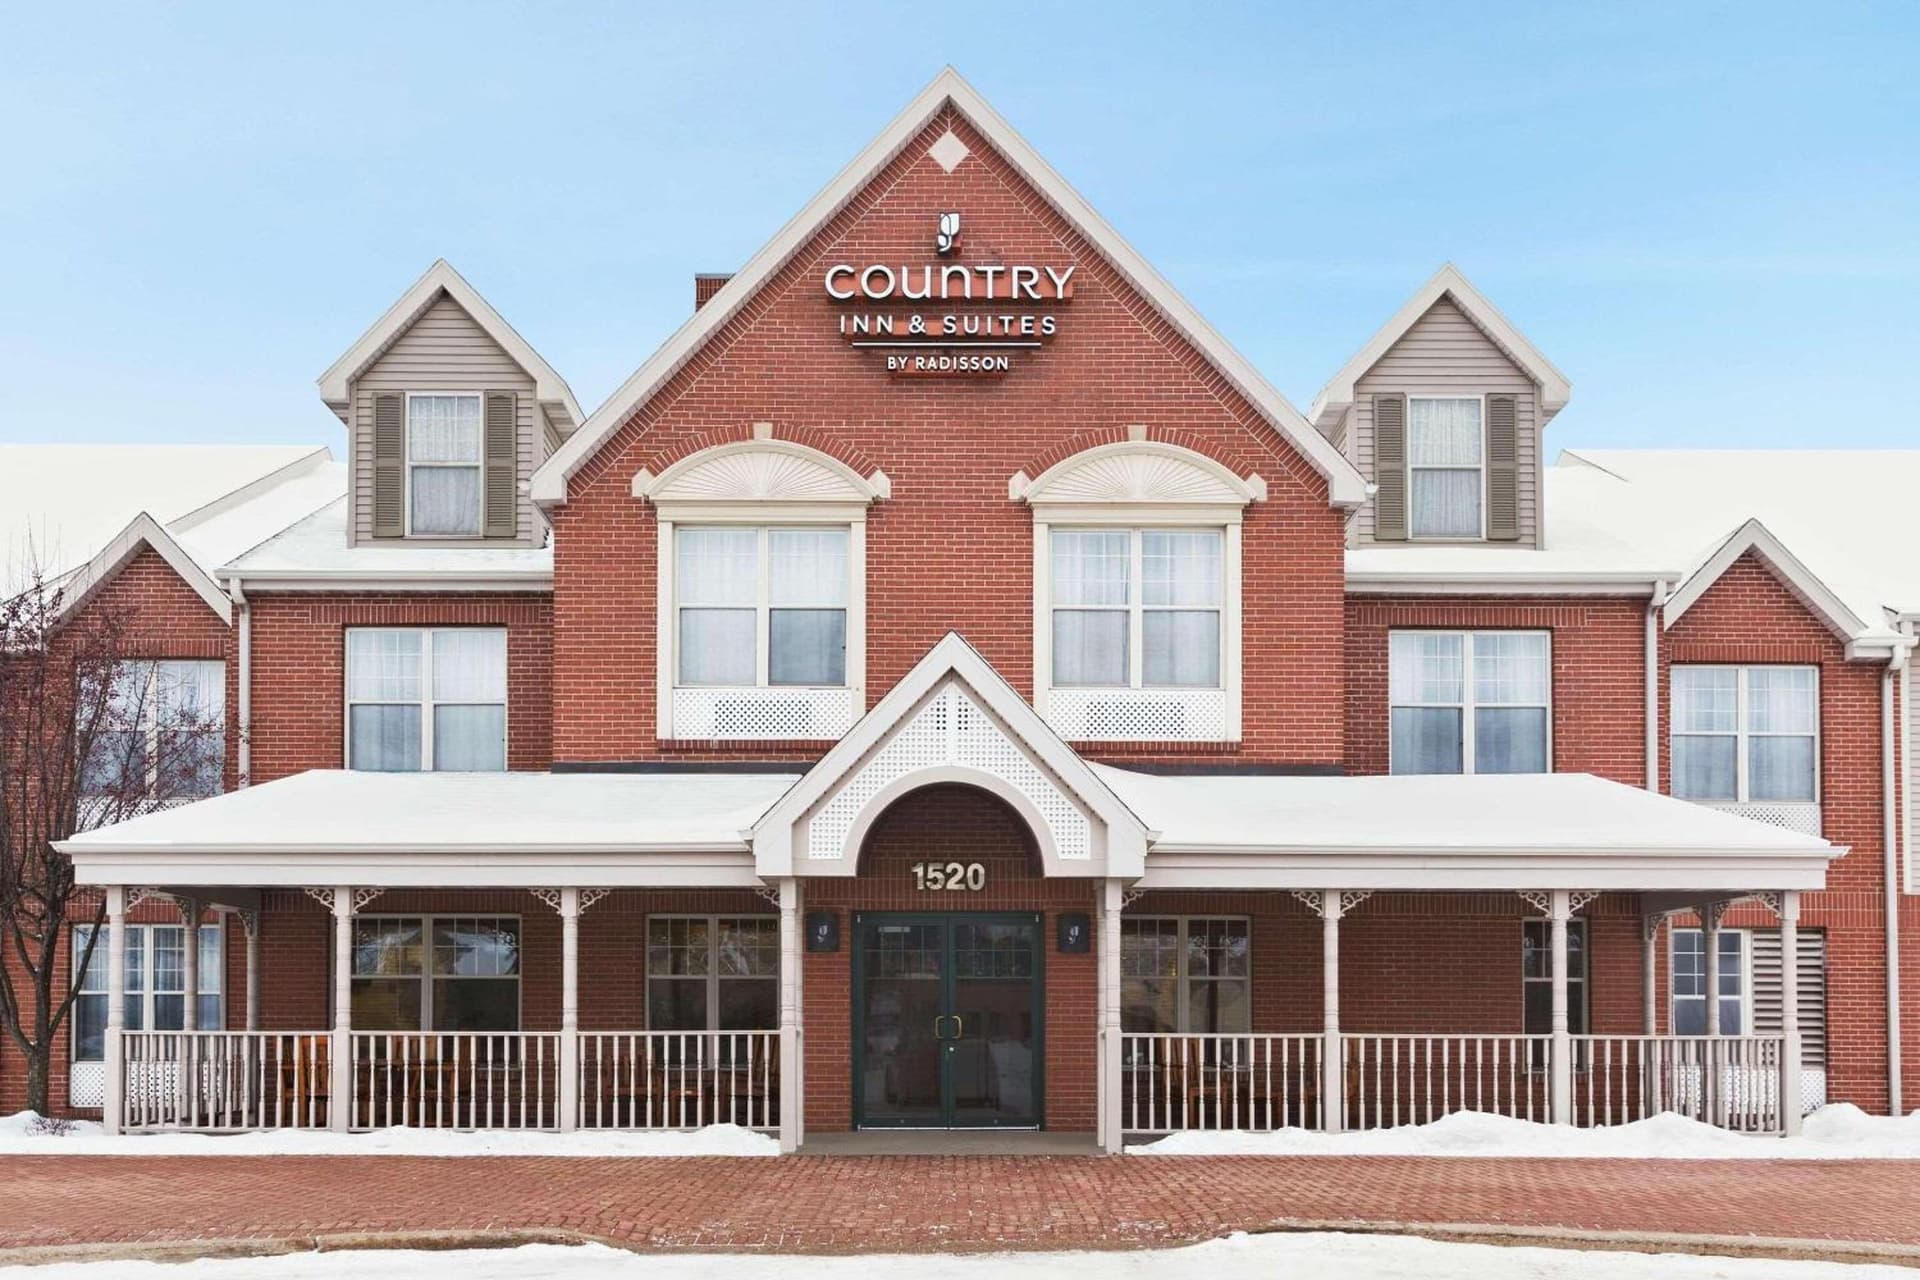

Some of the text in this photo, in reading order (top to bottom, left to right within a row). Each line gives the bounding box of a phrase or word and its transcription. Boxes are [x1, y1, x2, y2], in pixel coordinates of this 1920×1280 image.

[839, 314, 1057, 335] INN & SUITES
[887, 355, 1009, 372] BY RADISSON
[911, 861, 986, 891] 1520
